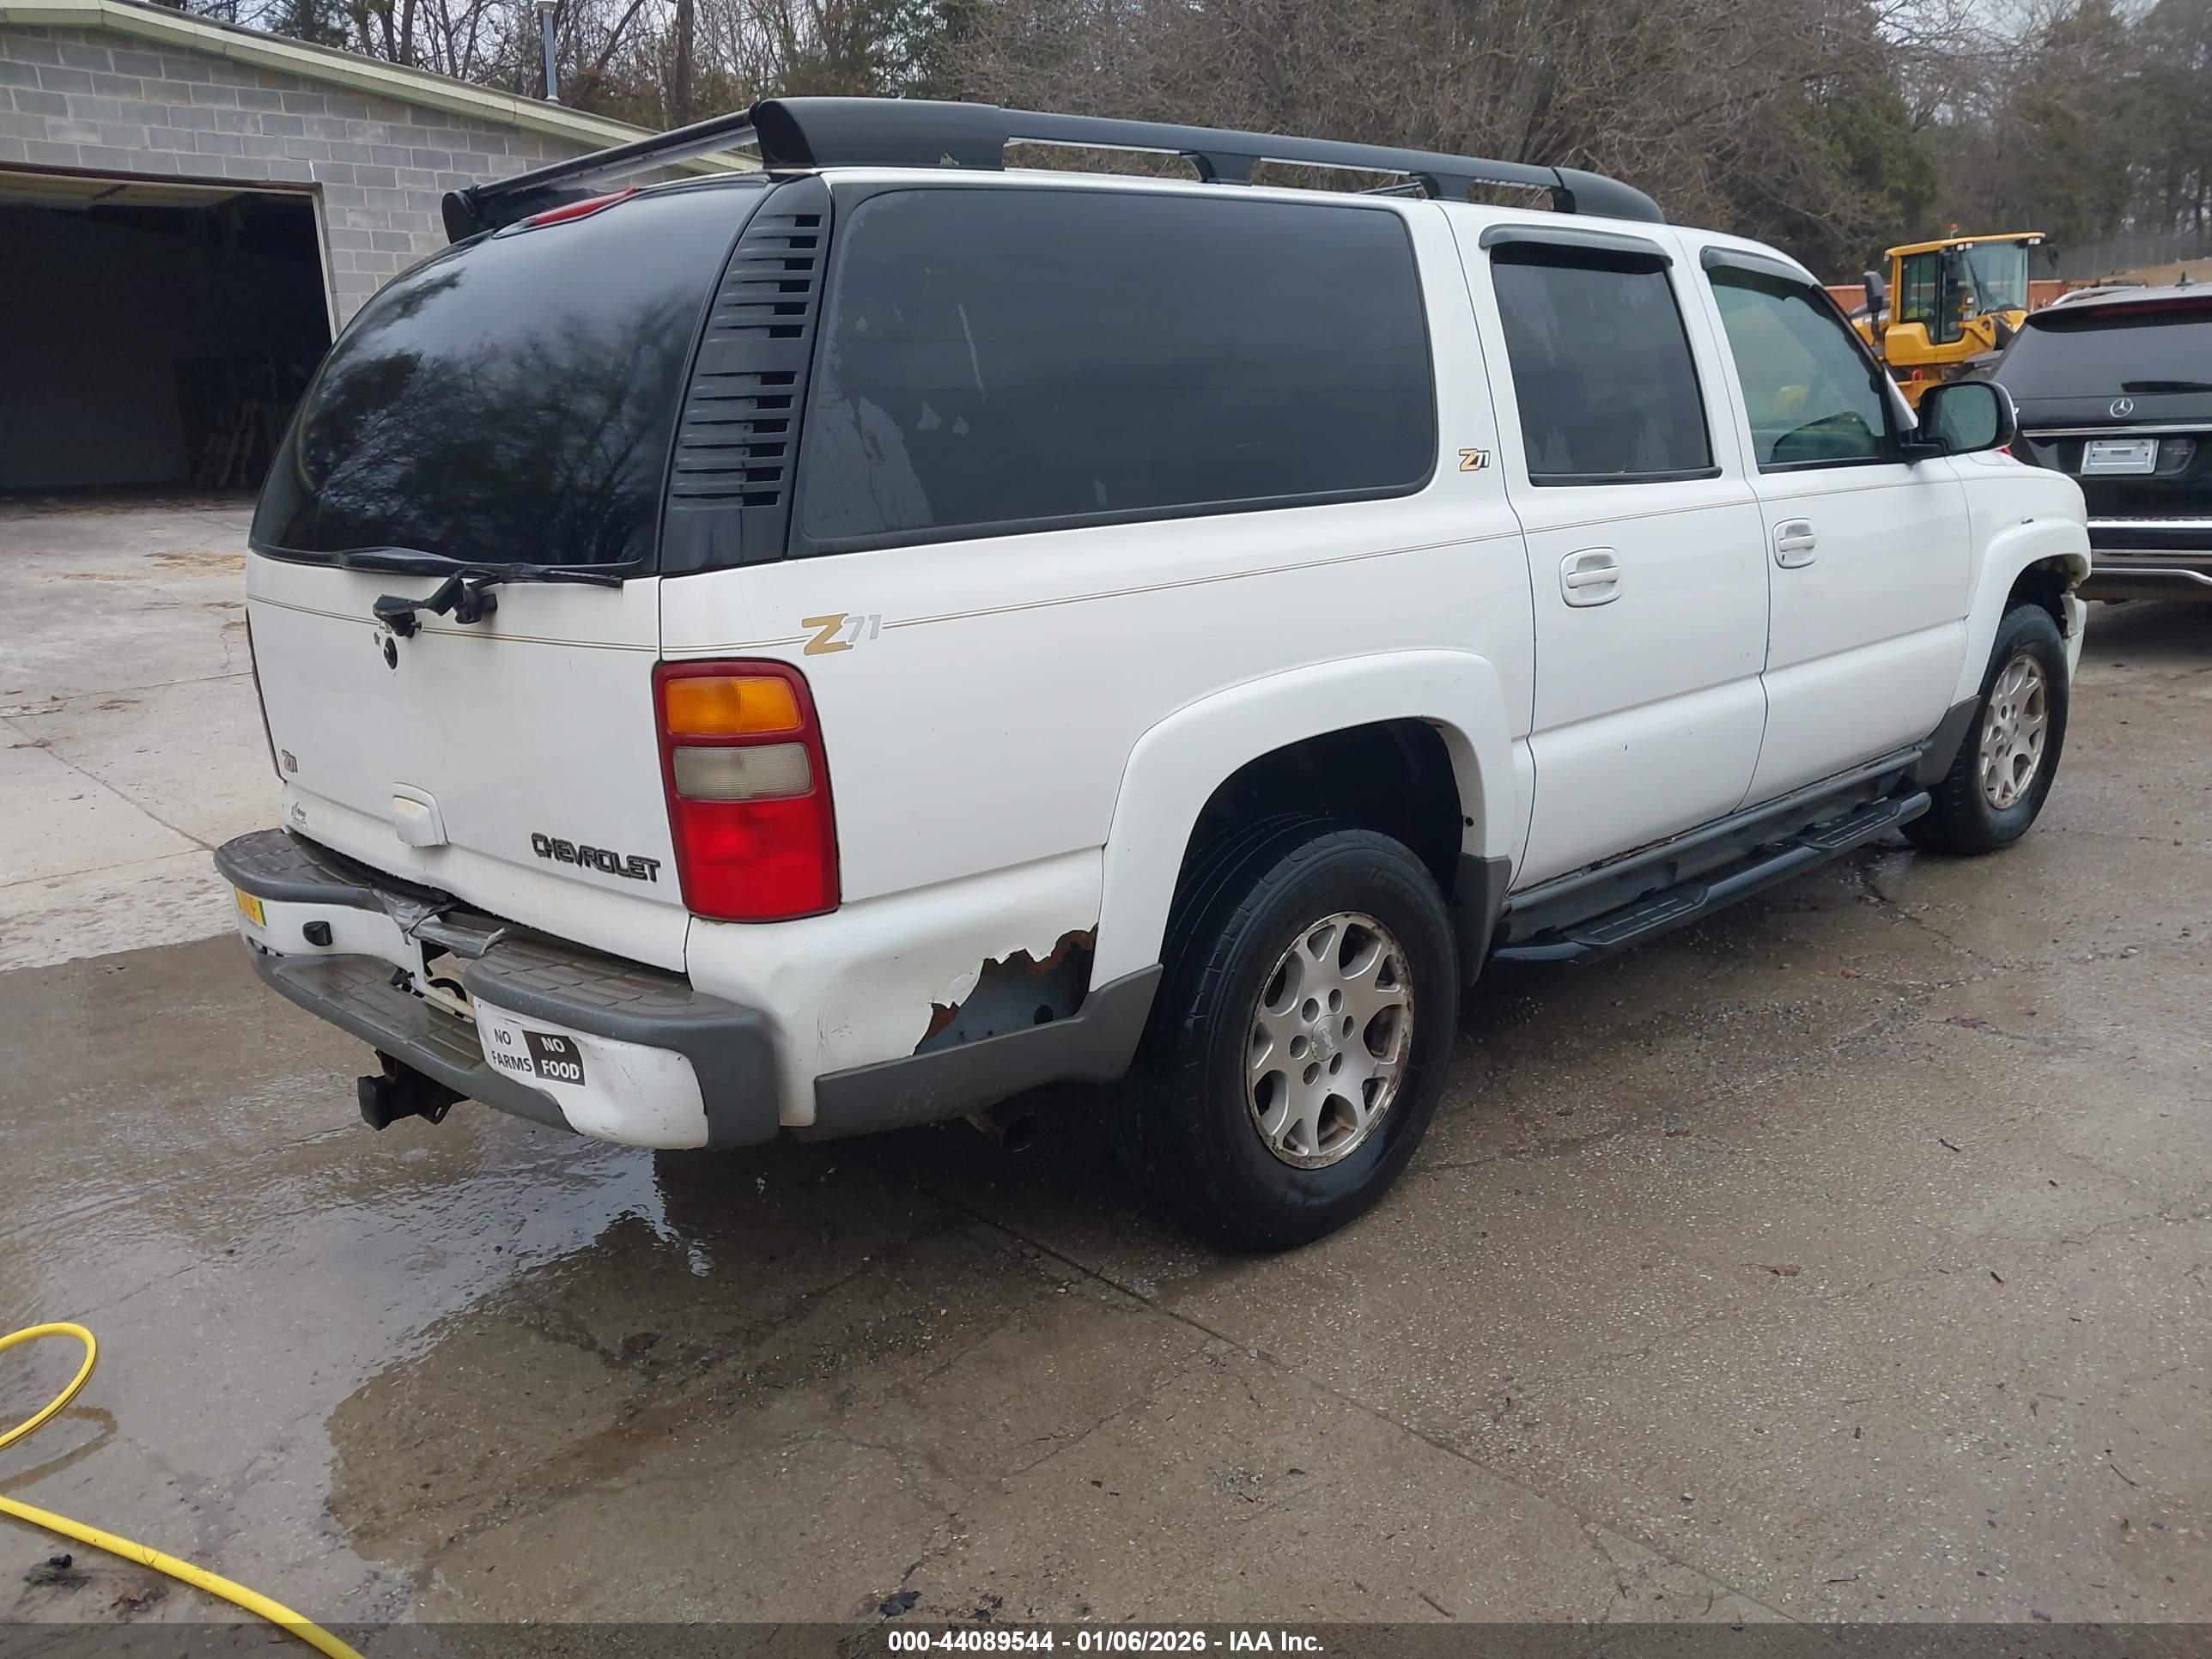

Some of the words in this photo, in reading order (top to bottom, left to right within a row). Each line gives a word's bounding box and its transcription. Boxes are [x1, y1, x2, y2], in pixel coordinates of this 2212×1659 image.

[1459, 448, 1490, 471] Z71
[801, 613, 882, 656] Z71
[531, 832, 661, 882] CHEVROLET
[494, 1028, 512, 1046] NO
[540, 1036, 565, 1053] NO
[491, 1050, 532, 1073] FARMS
[540, 1059, 580, 1079] FOOD
